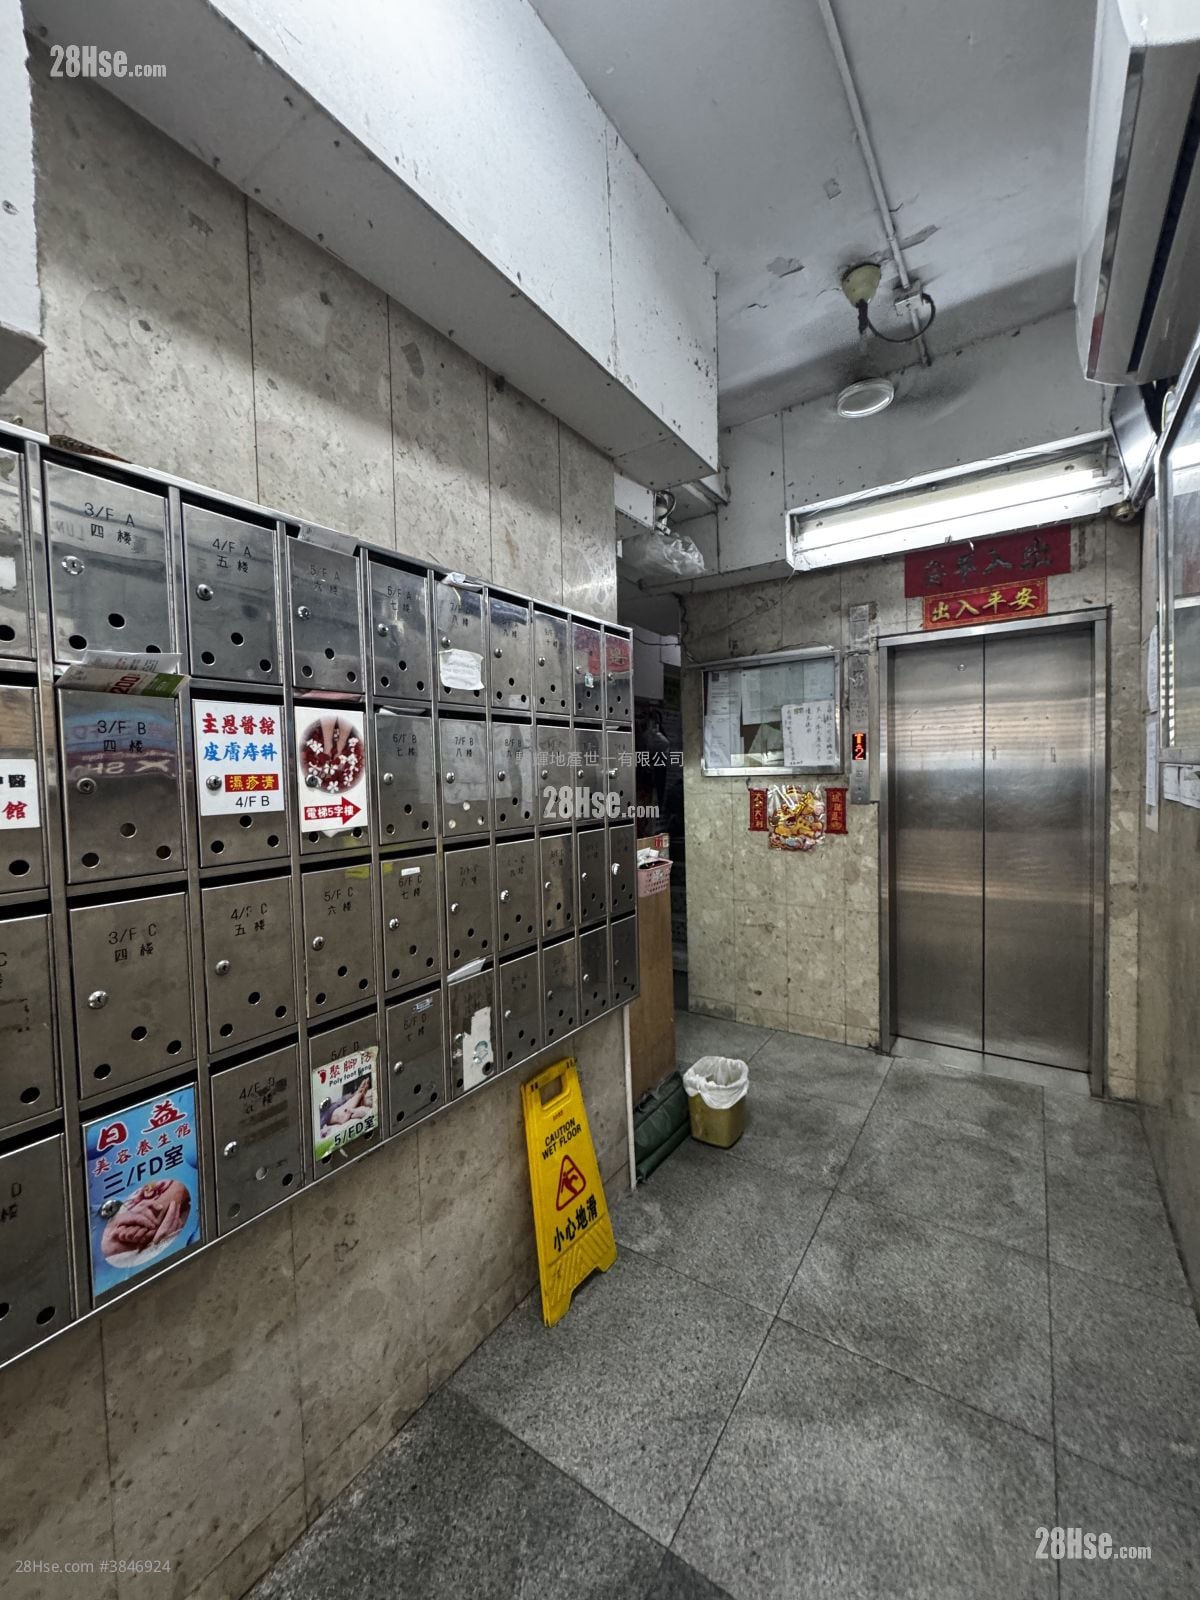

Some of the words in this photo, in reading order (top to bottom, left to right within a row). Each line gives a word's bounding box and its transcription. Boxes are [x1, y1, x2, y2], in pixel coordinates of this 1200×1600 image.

[84, 502, 114, 521] 3/F
[125, 514, 135, 527] A
[212, 538, 236, 553] 4/F
[244, 546, 252, 557] A
[931, 587, 1038, 622] 出入平安
[97, 720, 126, 734] 3/F
[138, 722, 146, 735] B
[203, 741, 278, 762] 皮膚痔科
[236, 796, 257, 808] 4/F
[261, 796, 270, 807] B
[324, 889, 342, 902] 5/F
[109, 927, 137, 945] 3/F
[148, 923, 157, 937] C
[542, 1144, 557, 1161] WET
[559, 1124, 582, 1149] FLOOR
[545, 1117, 576, 1147] CAUTION
[553, 1193, 598, 1252] 小心地滑
